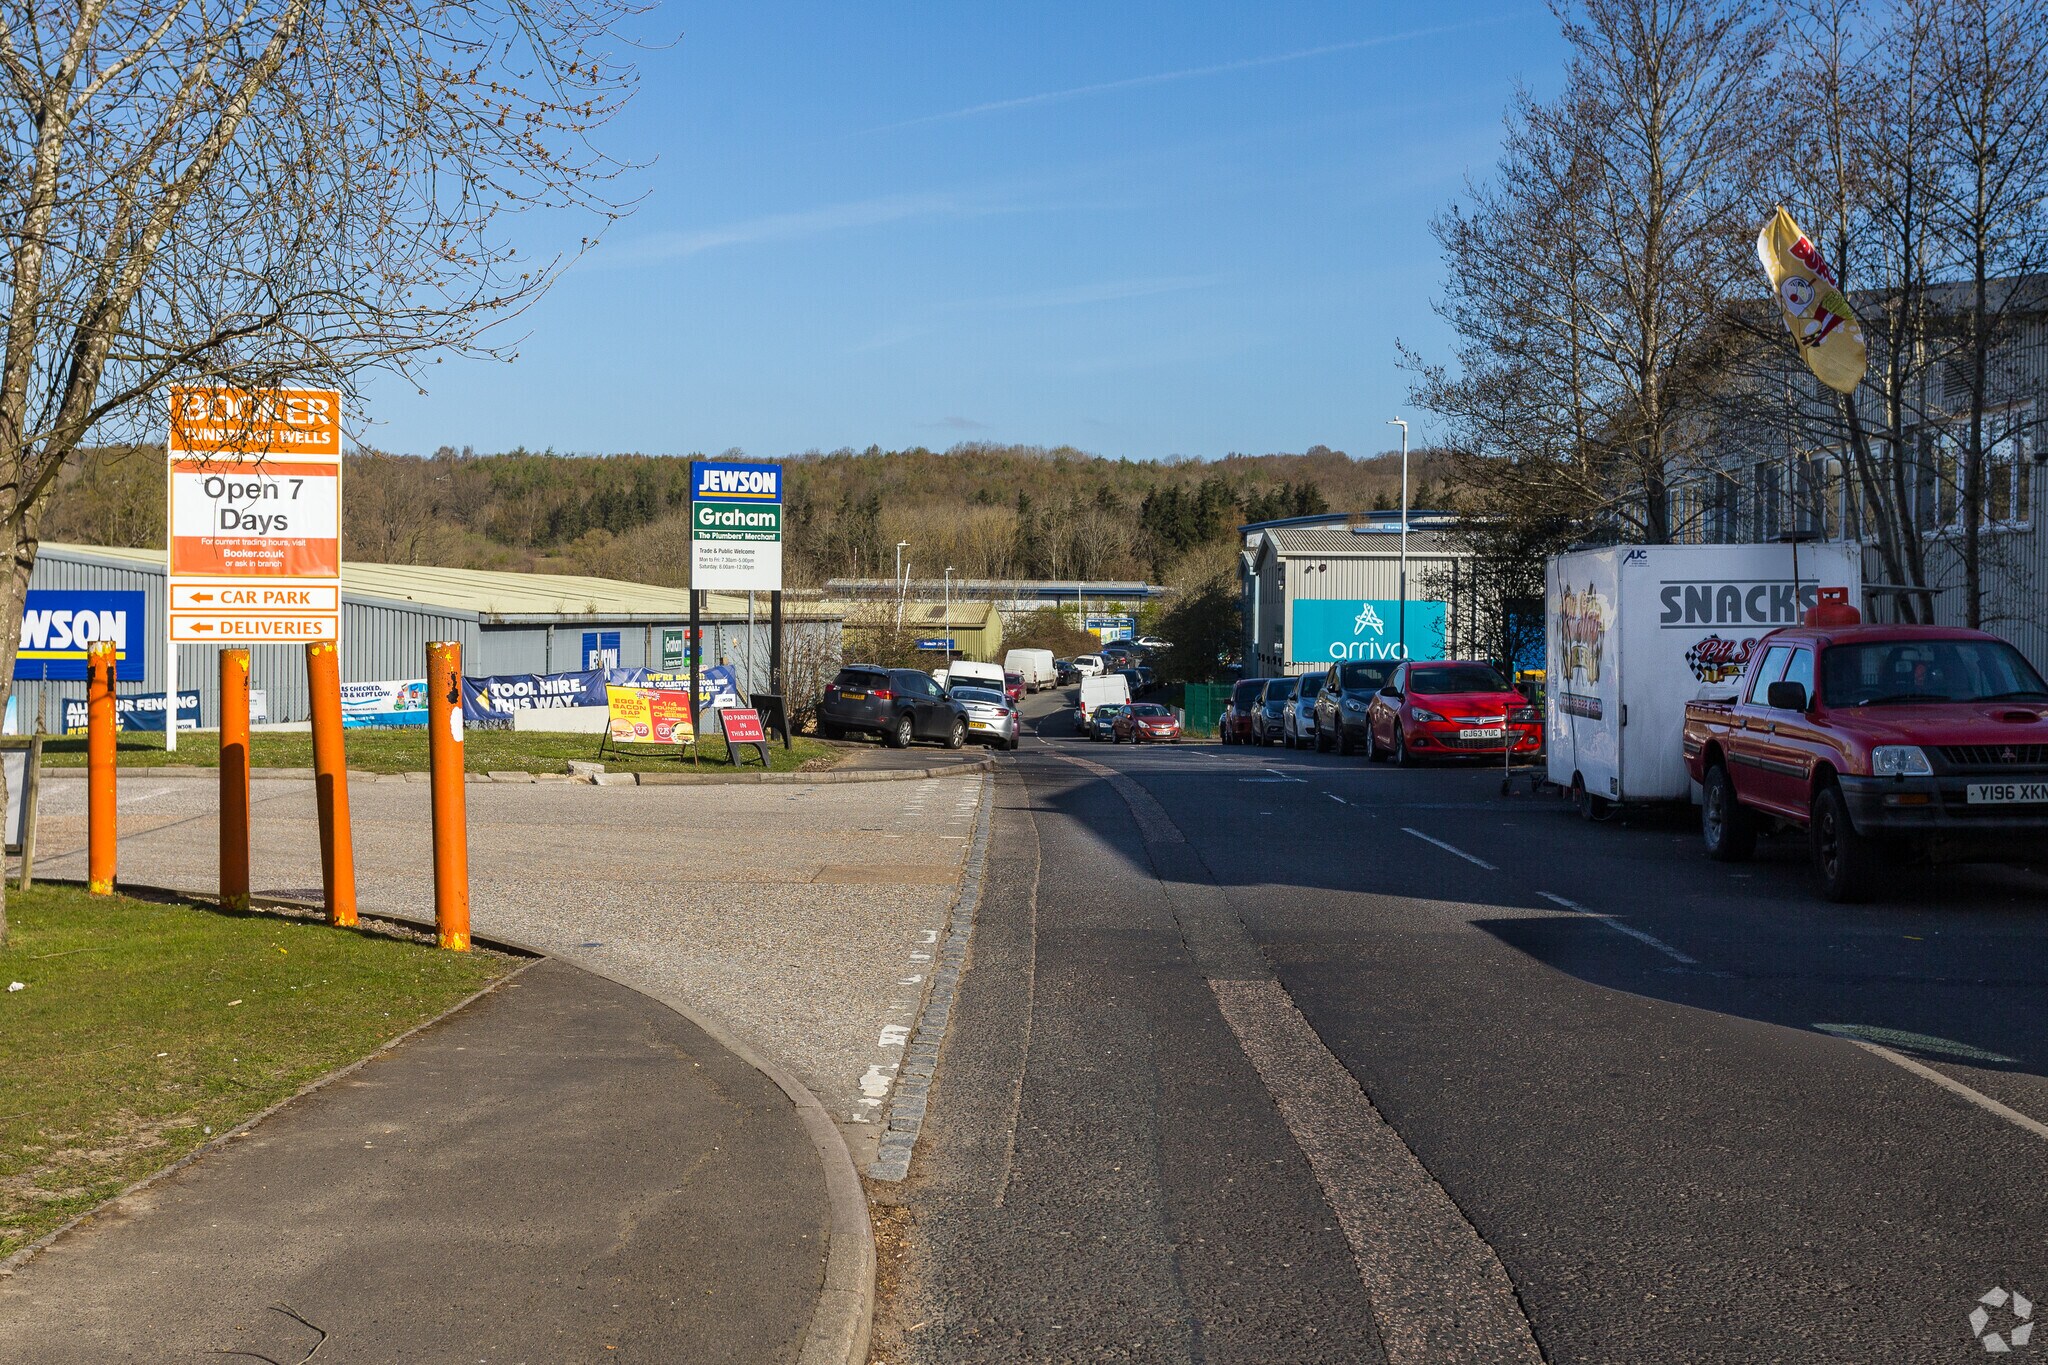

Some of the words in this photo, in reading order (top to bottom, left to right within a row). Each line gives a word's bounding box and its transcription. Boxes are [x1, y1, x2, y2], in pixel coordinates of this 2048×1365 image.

[280, 431, 331, 444] WELLS
[698, 469, 777, 493] JEWSON
[203, 476, 279, 504] Open
[288, 478, 304, 500] 7
[220, 508, 289, 536] Days
[698, 507, 776, 527] Graham
[242, 539, 267, 547] trading
[268, 539, 290, 547] hours,
[699, 531, 710, 539] The
[744, 533, 776, 541] Merchant
[223, 548, 285, 558] Booker.co.uk
[1623, 550, 1648, 565] AJC
[257, 560, 283, 568] branch
[220, 590, 258, 604] CAR
[263, 591, 311, 605] PARK
[1660, 585, 1819, 624] SNACKS
[220, 621, 323, 635] DELIVERIES
[1329, 637, 1409, 660] arriva
[1696, 638, 1737, 664] Pit
[1719, 666, 1749, 675] CAF
[350, 685, 382, 693] CHECKED.
[490, 681, 538, 698] TOOL
[540, 678, 587, 695] HIRE.
[491, 697, 532, 714] THIS
[533, 695, 579, 708] WAY.
[653, 711, 688, 719] CHEESE
[1484, 729, 1498, 737] YUC
[1979, 785, 2015, 800] Y196
